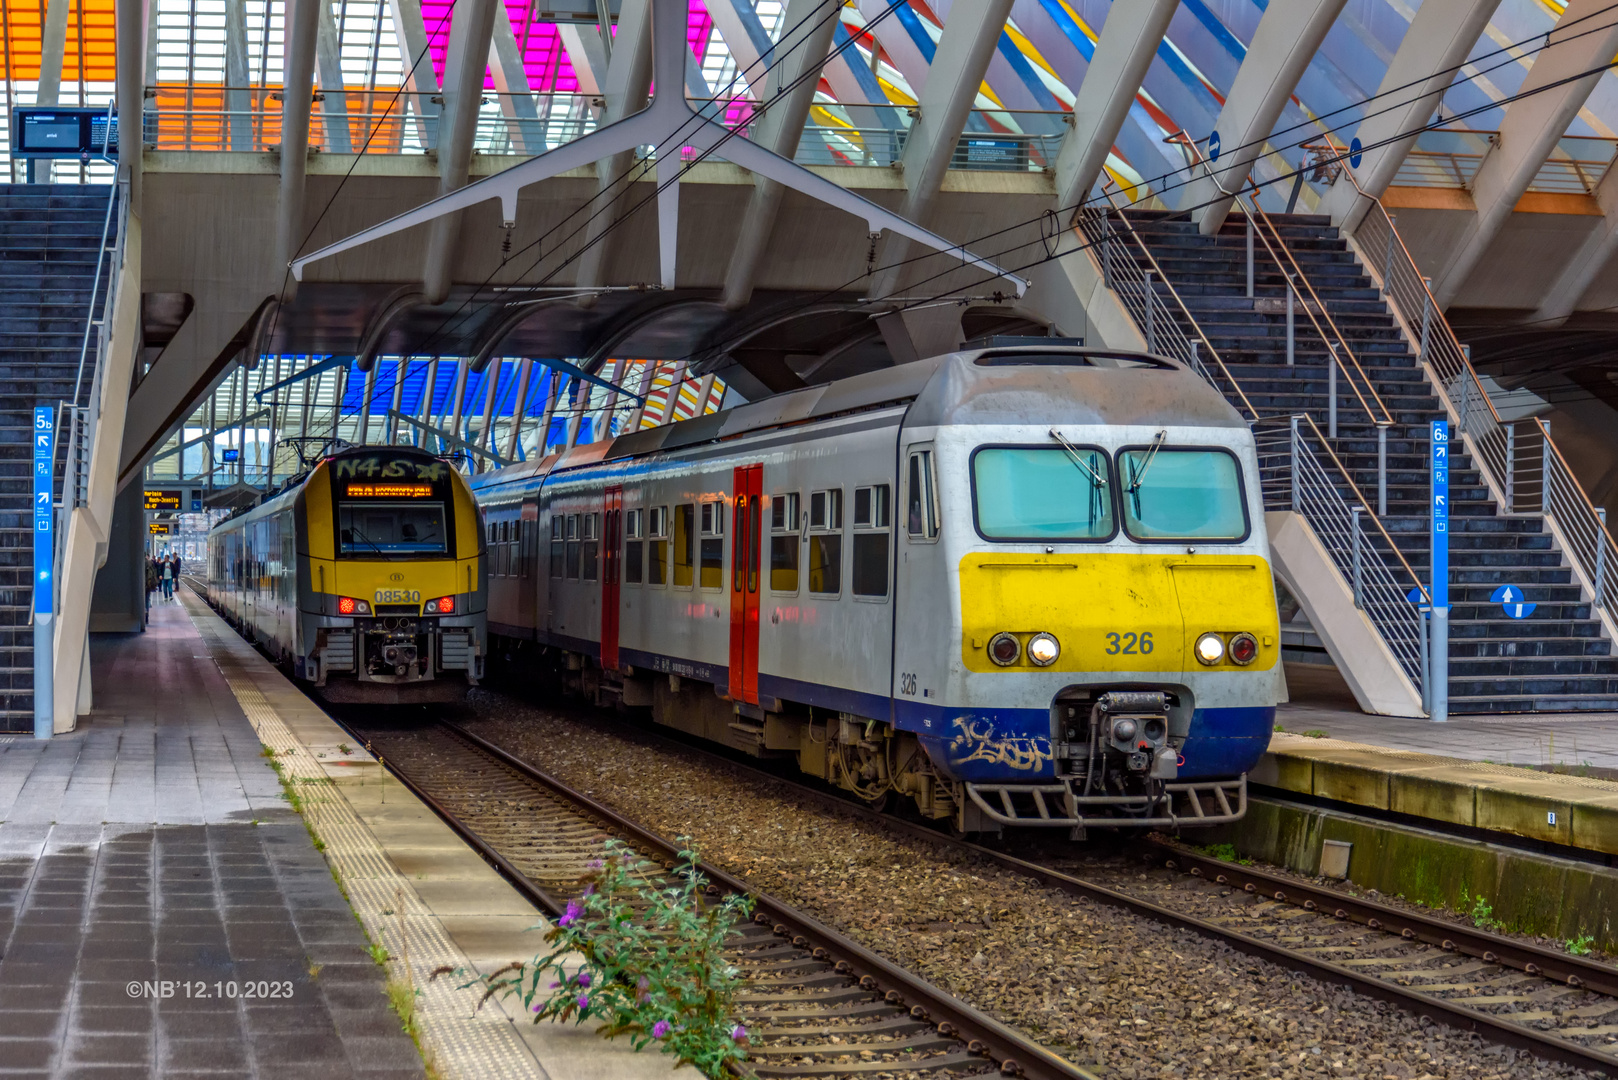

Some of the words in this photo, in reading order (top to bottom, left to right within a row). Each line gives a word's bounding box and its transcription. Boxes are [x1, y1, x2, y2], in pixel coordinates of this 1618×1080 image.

[36, 415, 52, 429] 5b
[1434, 428, 1448, 441] 6b
[802, 510, 808, 543] 2
[374, 590, 421, 603] 08530
[1105, 631, 1154, 655] 326
[901, 672, 917, 696] 326
